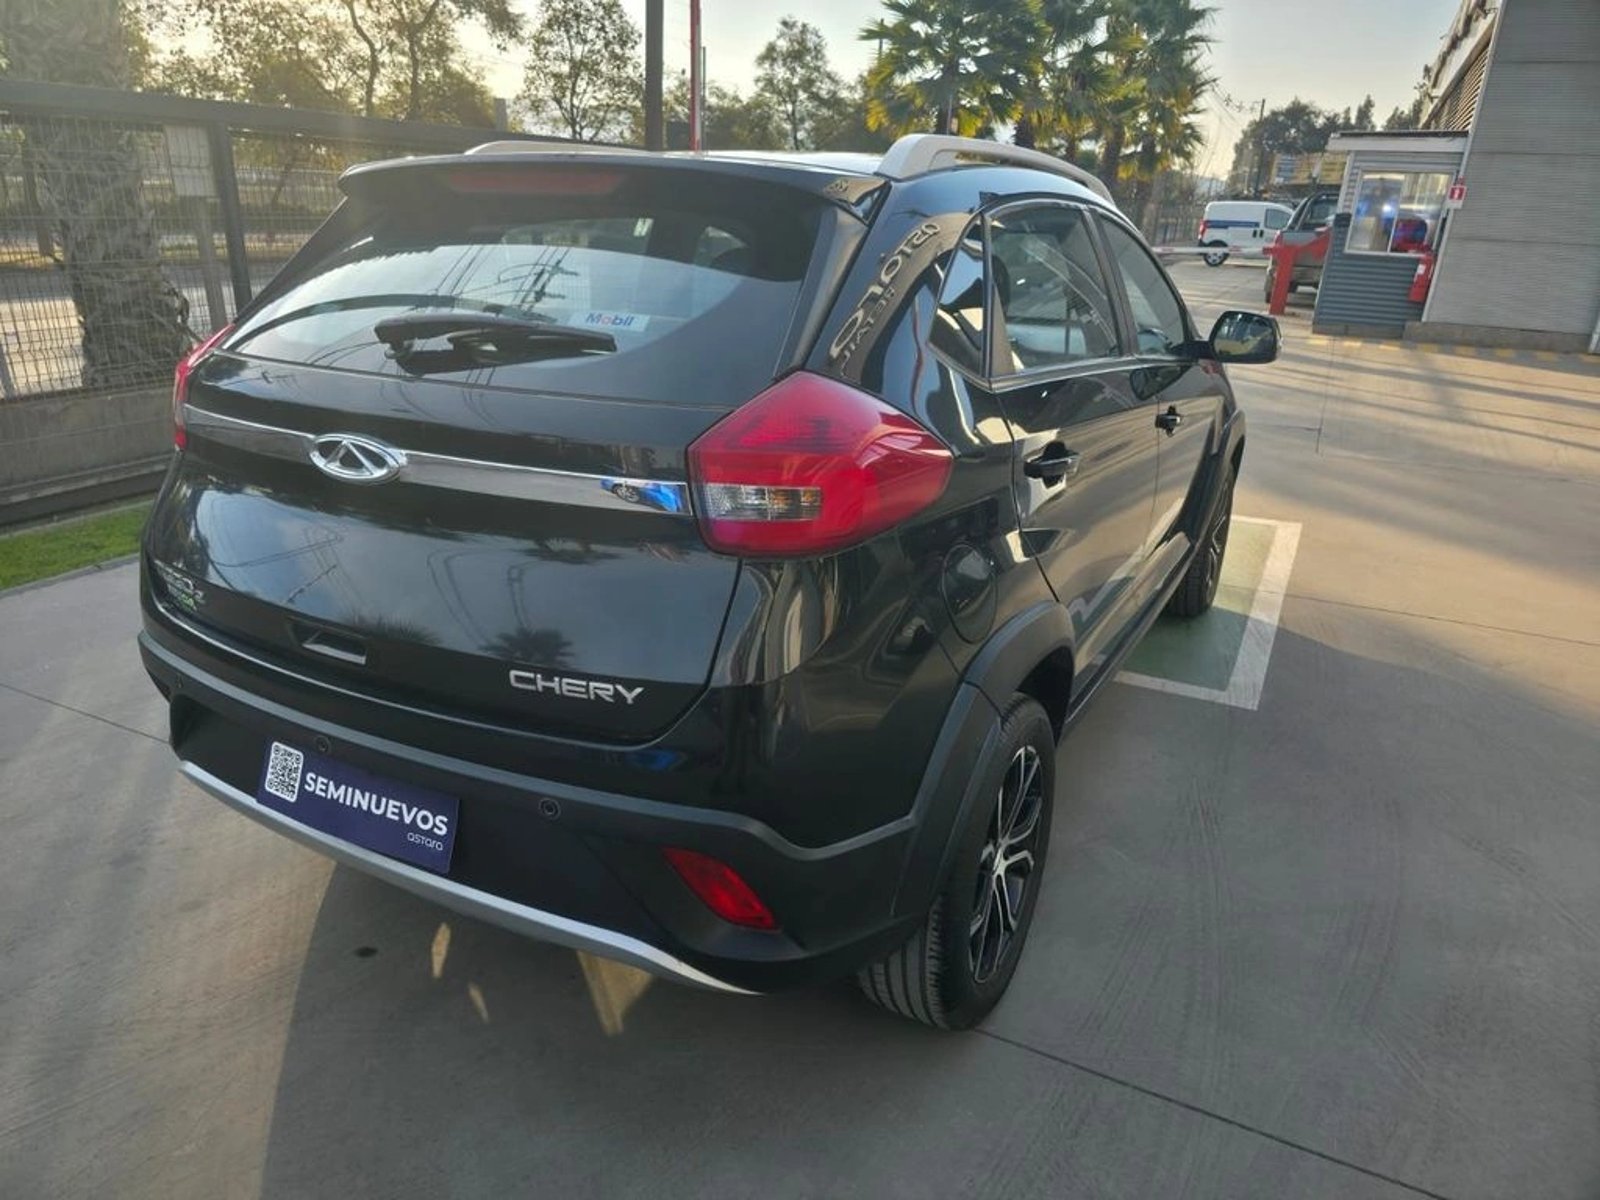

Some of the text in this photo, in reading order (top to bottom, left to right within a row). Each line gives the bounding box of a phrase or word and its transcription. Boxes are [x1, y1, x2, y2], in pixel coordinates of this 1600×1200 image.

[586, 312, 634, 326] Mobil
[509, 669, 644, 704] CHERY
[304, 773, 448, 835] SEMINUEVOS
[407, 832, 444, 851] astara
